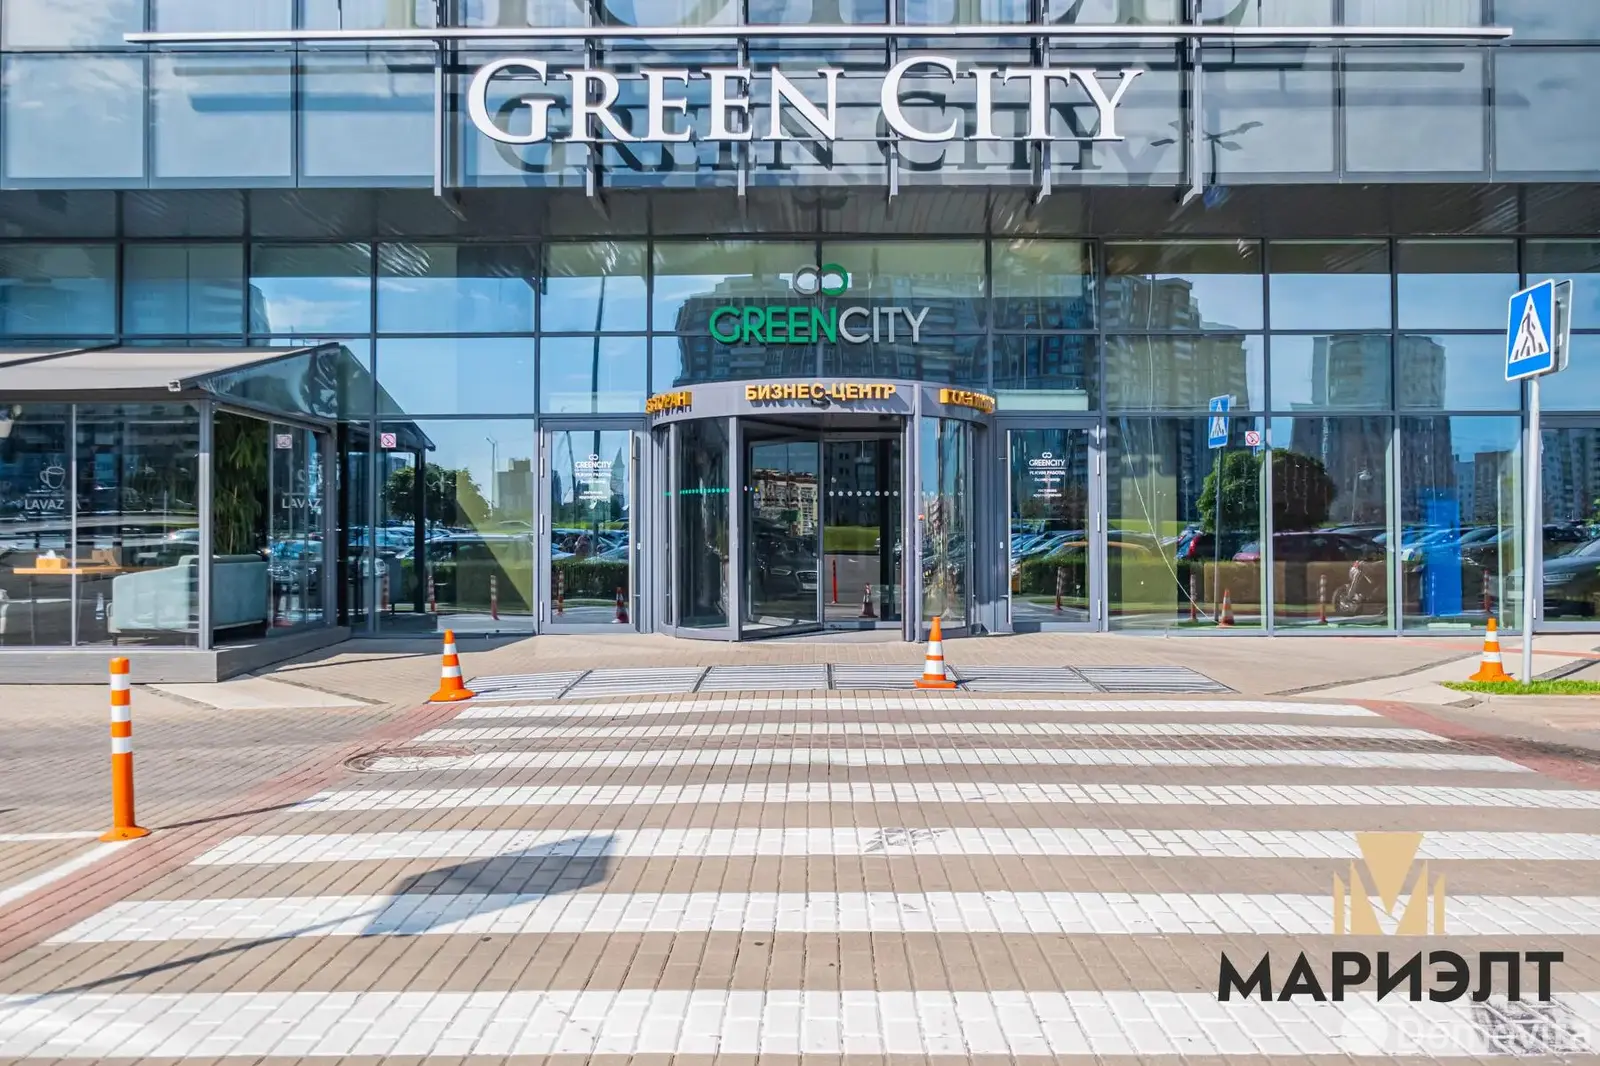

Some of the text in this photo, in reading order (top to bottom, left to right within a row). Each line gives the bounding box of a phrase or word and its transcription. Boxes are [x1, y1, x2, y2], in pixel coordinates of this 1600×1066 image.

[467, 56, 1145, 145] GREEN CITY
[708, 305, 930, 345] GREENCITY
[745, 382, 897, 401] БИЗНЕС-ЦЕНТР
[1028, 459, 1066, 467] GREENCITY
[24, 499, 82, 510] LAVAZ
